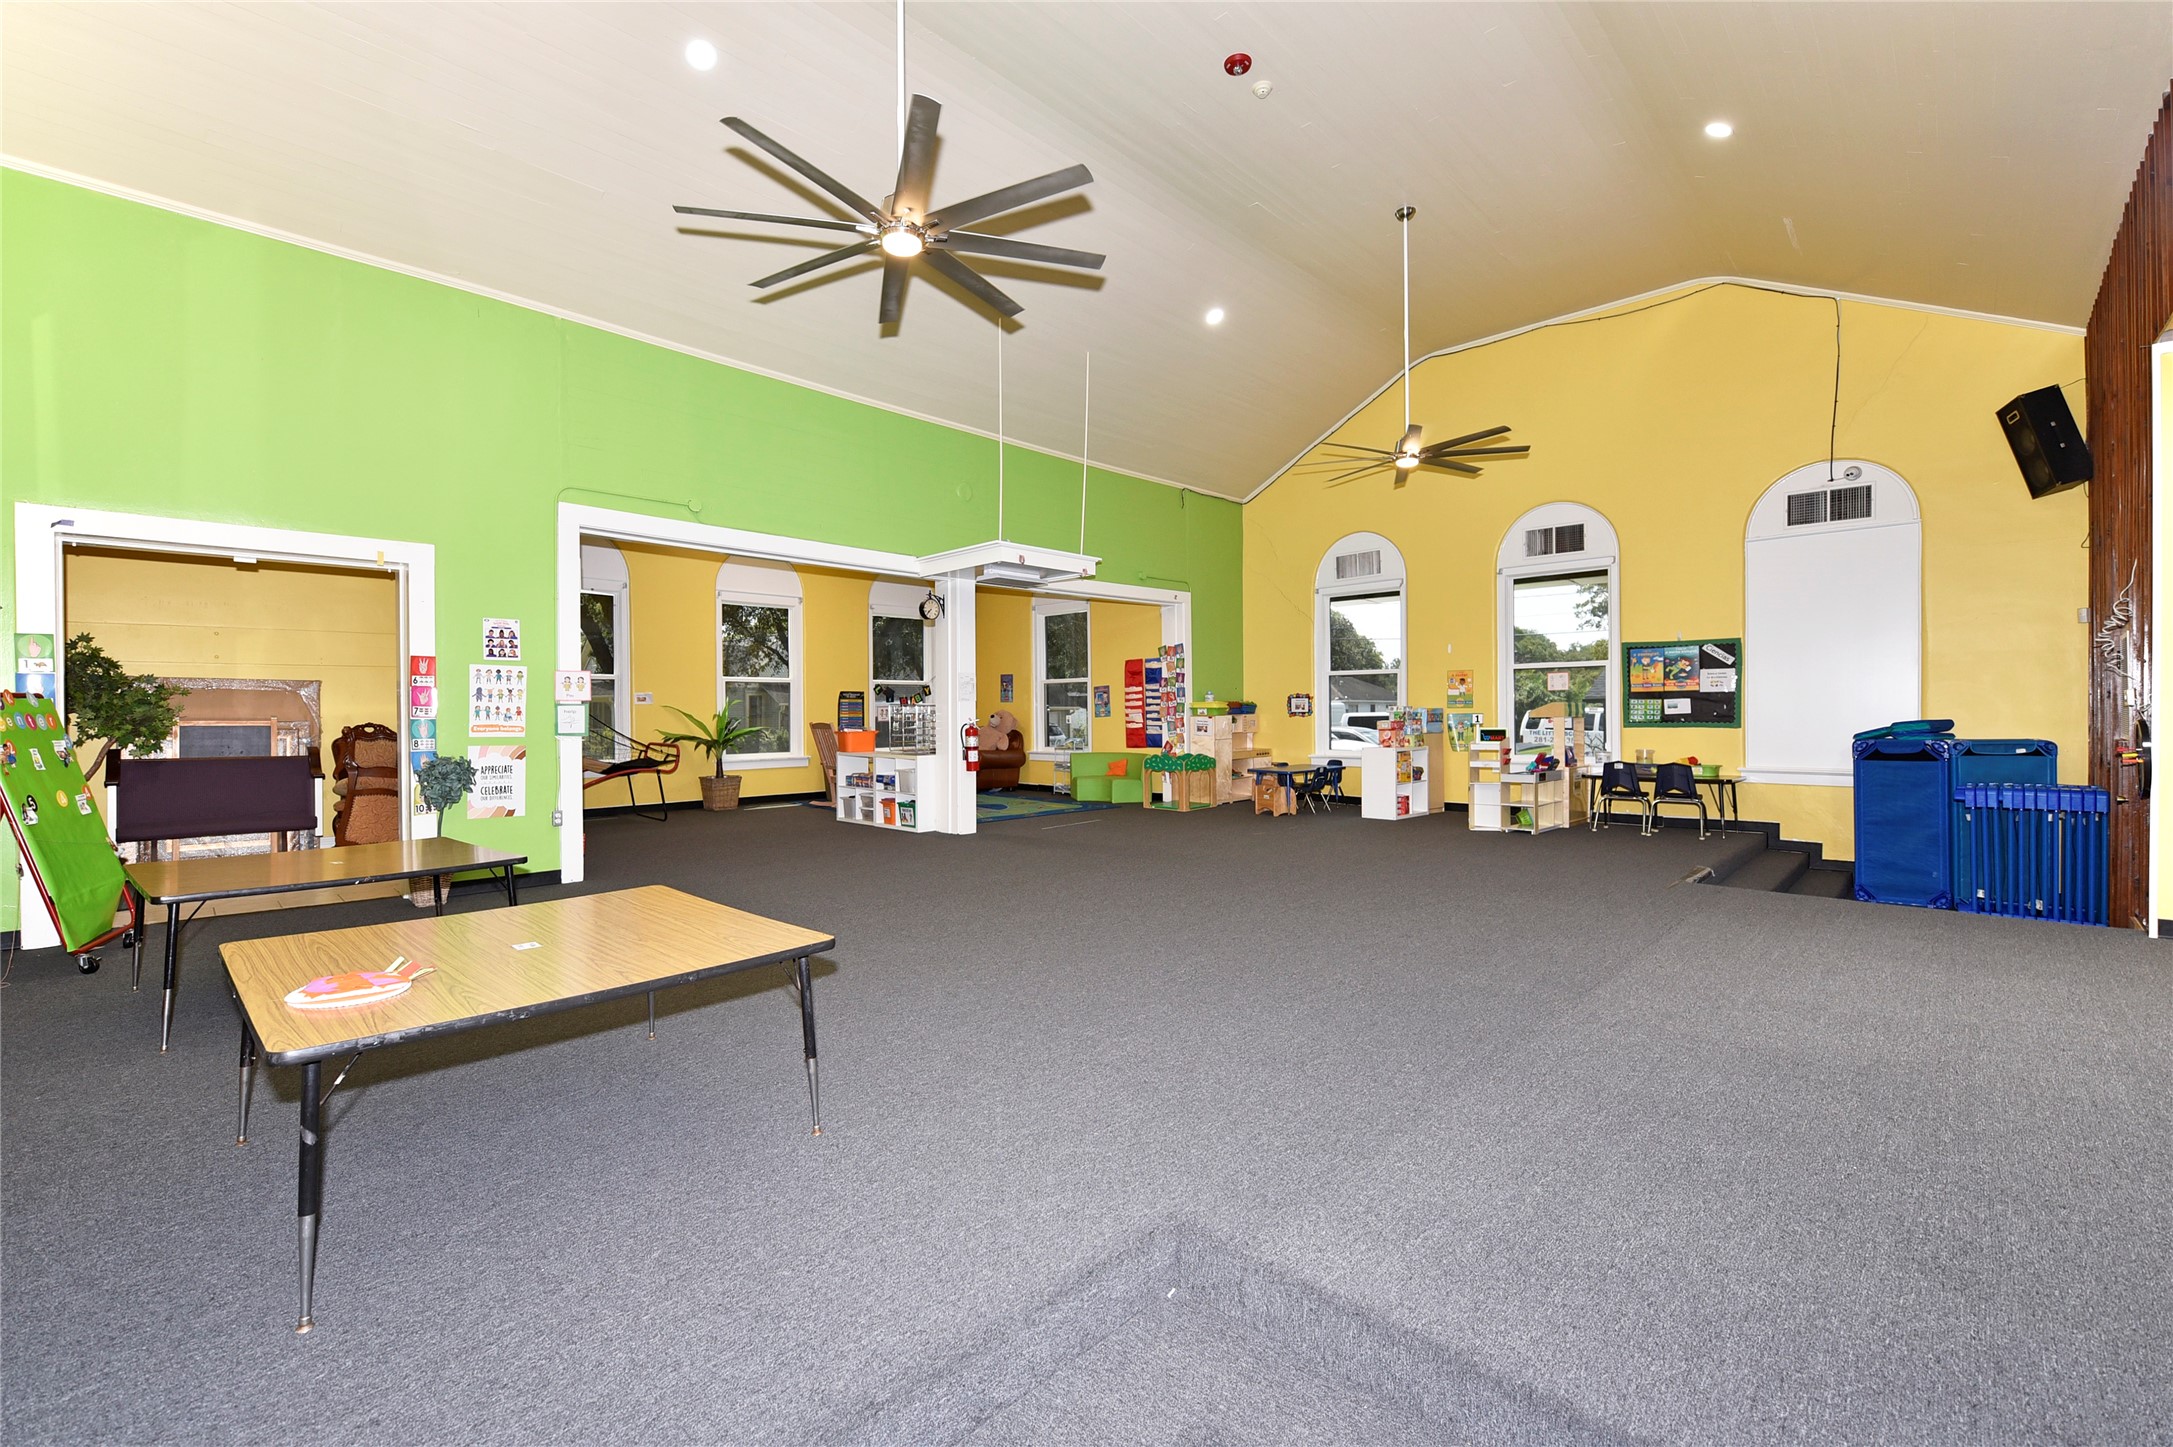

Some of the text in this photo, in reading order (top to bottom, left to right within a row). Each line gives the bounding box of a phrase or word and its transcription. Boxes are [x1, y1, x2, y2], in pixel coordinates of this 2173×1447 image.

[1706, 645, 1730, 661] Ciencias
[413, 677, 418, 685] 6
[414, 707, 419, 715] 7
[1475, 715, 1480, 723] 1
[413, 740, 419, 748] 8
[481, 765, 513, 774] APPRECIATE
[480, 786, 513, 795] CELEBRATE
[28, 796, 36, 809] 5
